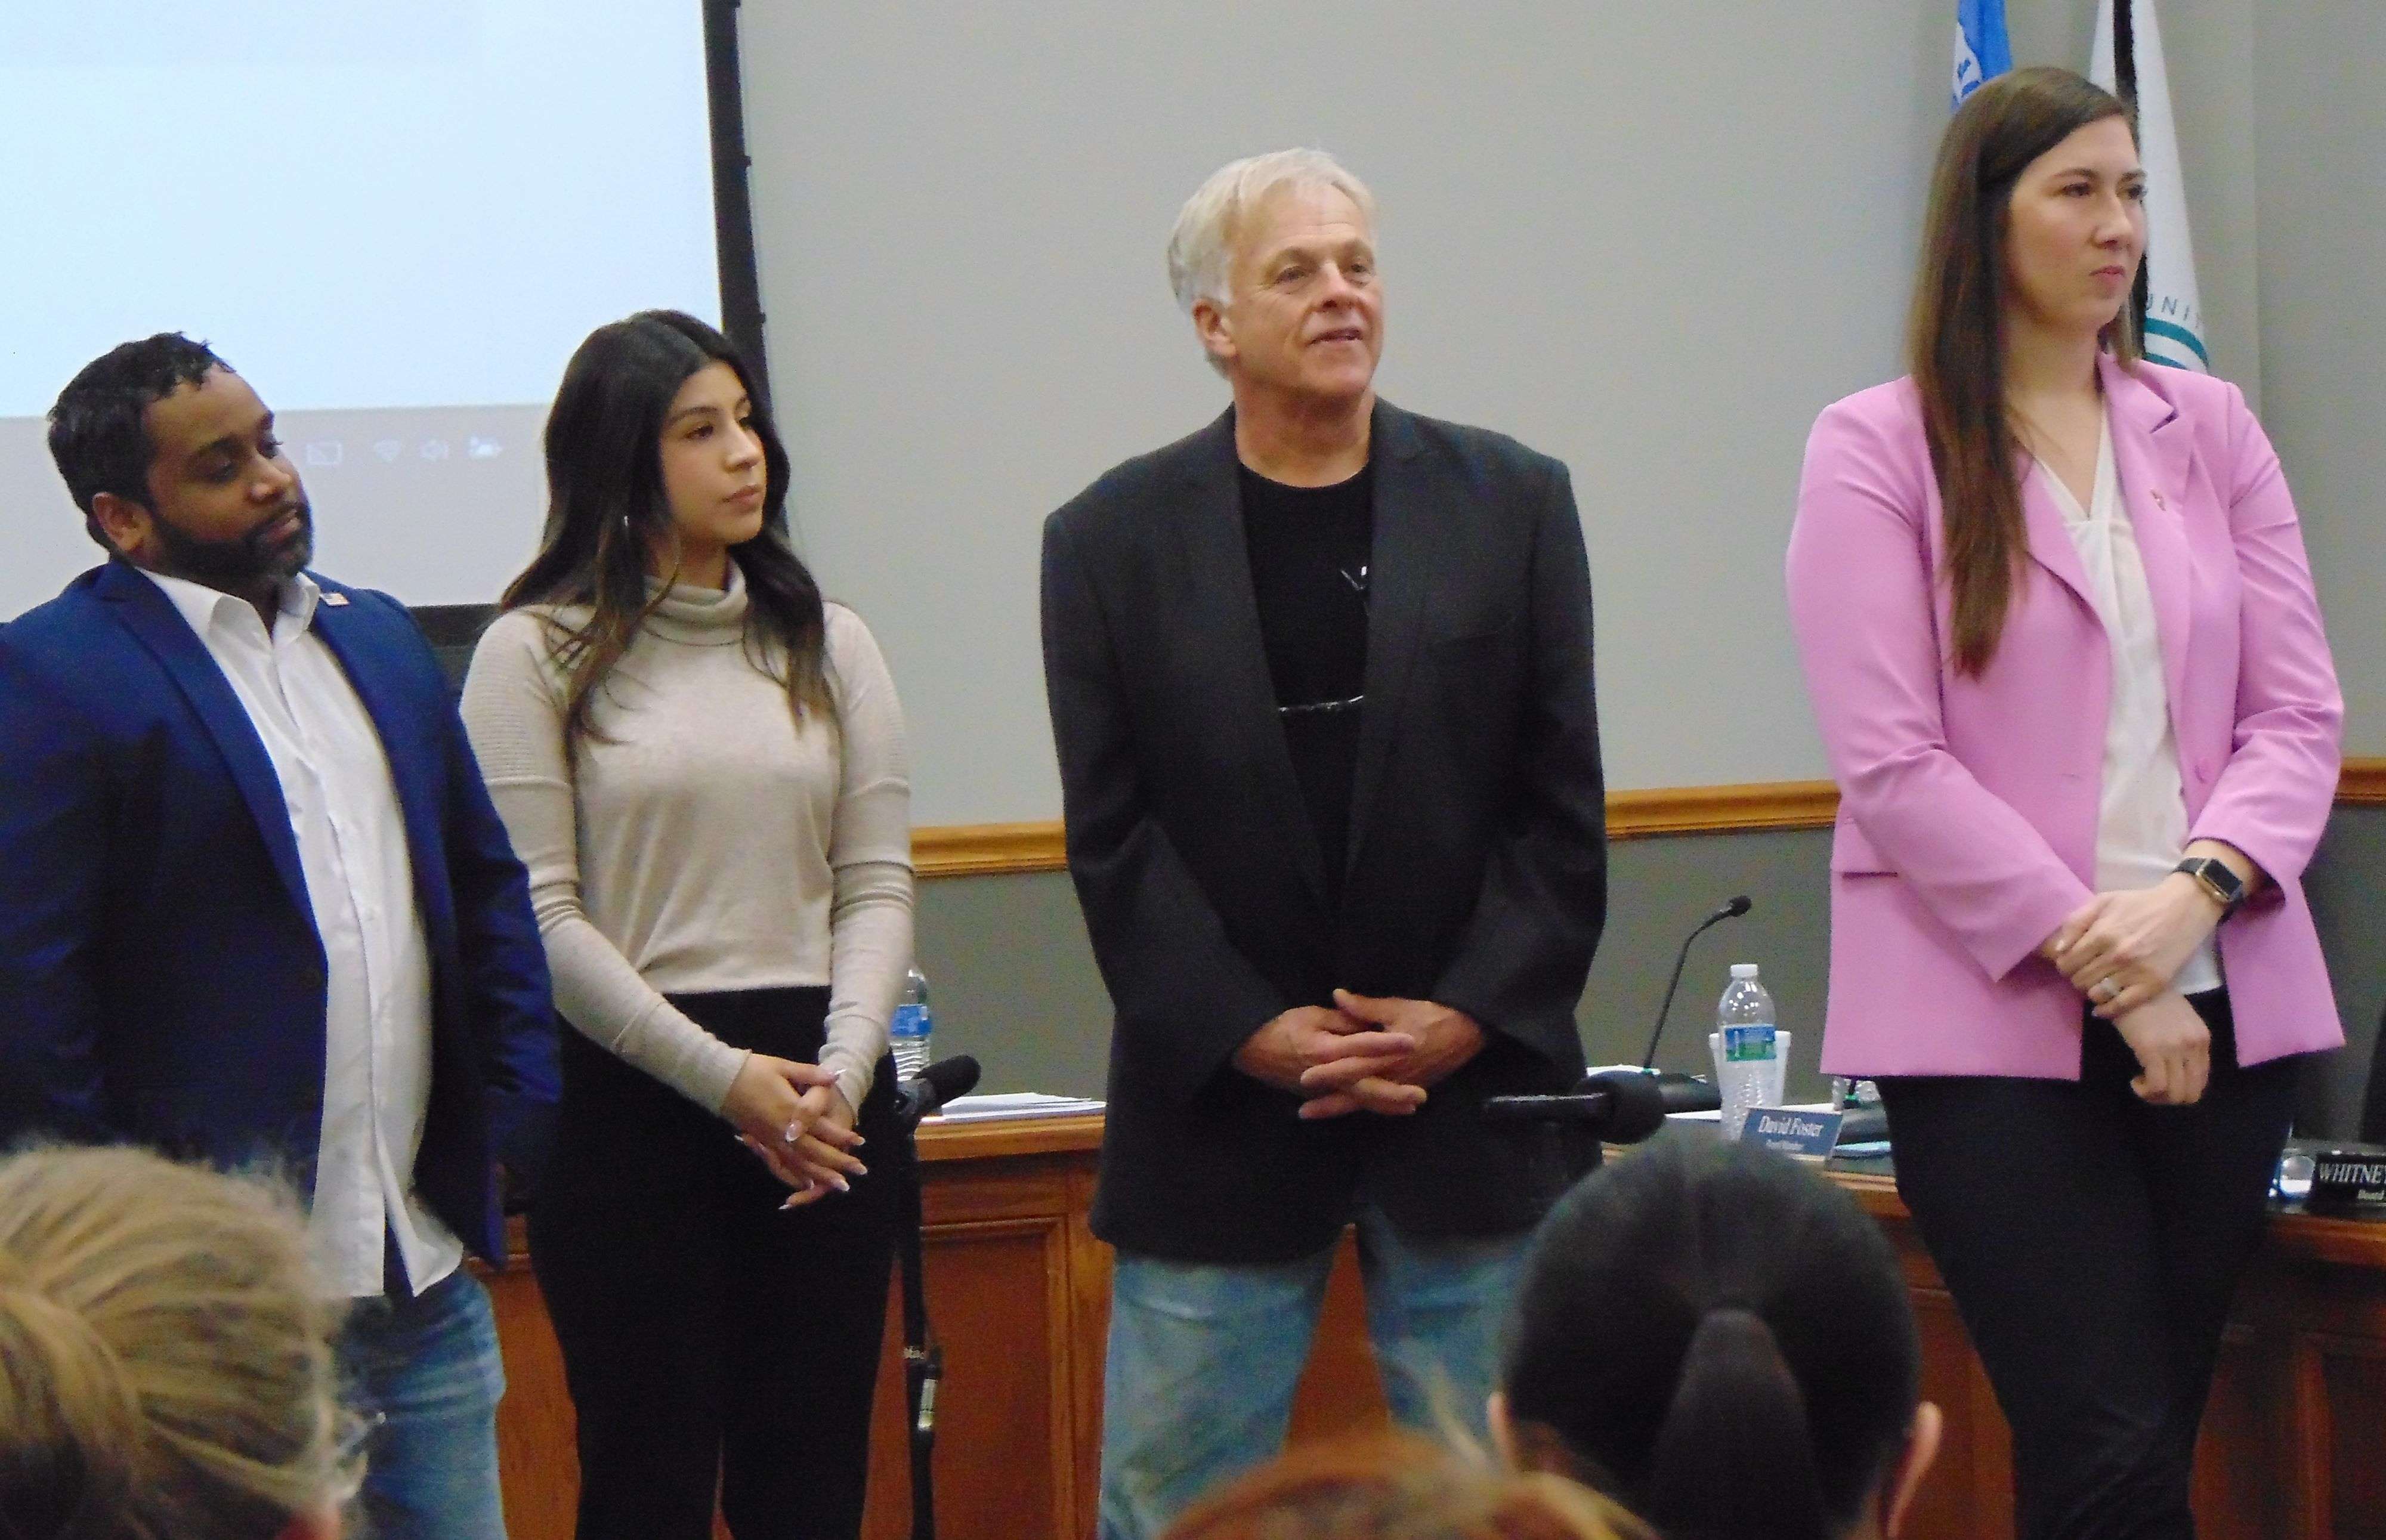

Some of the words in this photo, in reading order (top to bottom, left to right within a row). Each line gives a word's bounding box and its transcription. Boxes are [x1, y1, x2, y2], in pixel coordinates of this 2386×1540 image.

[1758, 1115, 1791, 1134] David
[1791, 1117, 1824, 1137] Foster
[2320, 1163, 2386, 1184] WHITNE
